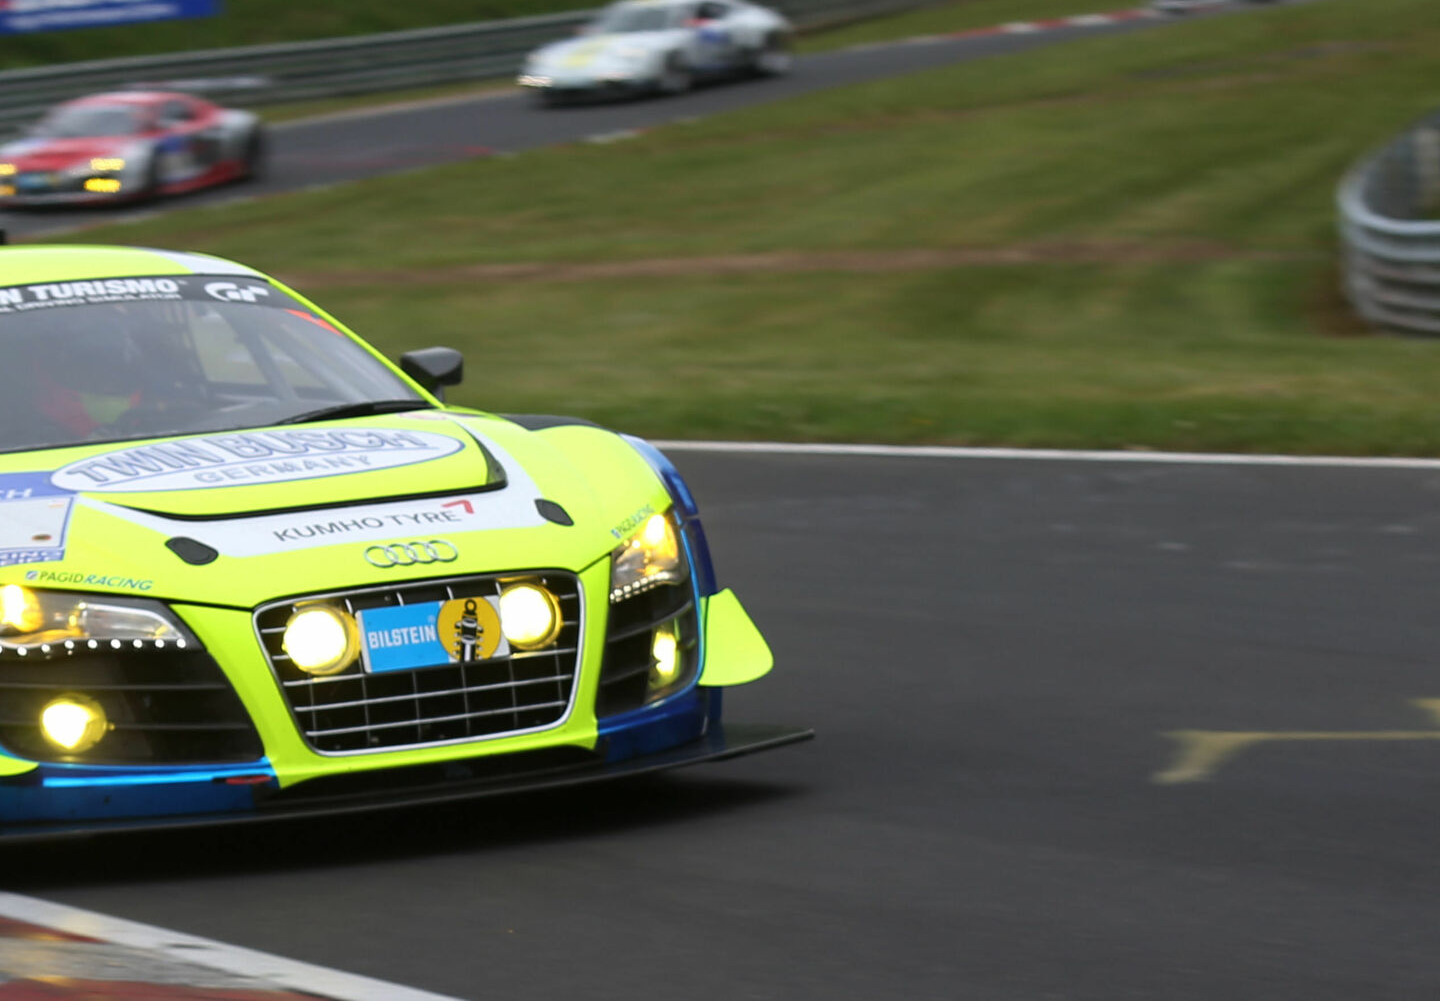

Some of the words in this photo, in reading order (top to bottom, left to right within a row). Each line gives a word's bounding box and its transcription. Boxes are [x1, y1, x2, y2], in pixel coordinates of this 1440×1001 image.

[27, 278, 180, 301] TURISMO
[66, 441, 226, 483] TWIN
[202, 430, 428, 459] BUSCH
[193, 455, 372, 483] GERMANY
[273, 517, 383, 542] KUMHO
[386, 509, 462, 526] TYRE
[367, 623, 438, 650] BILSTEIN
